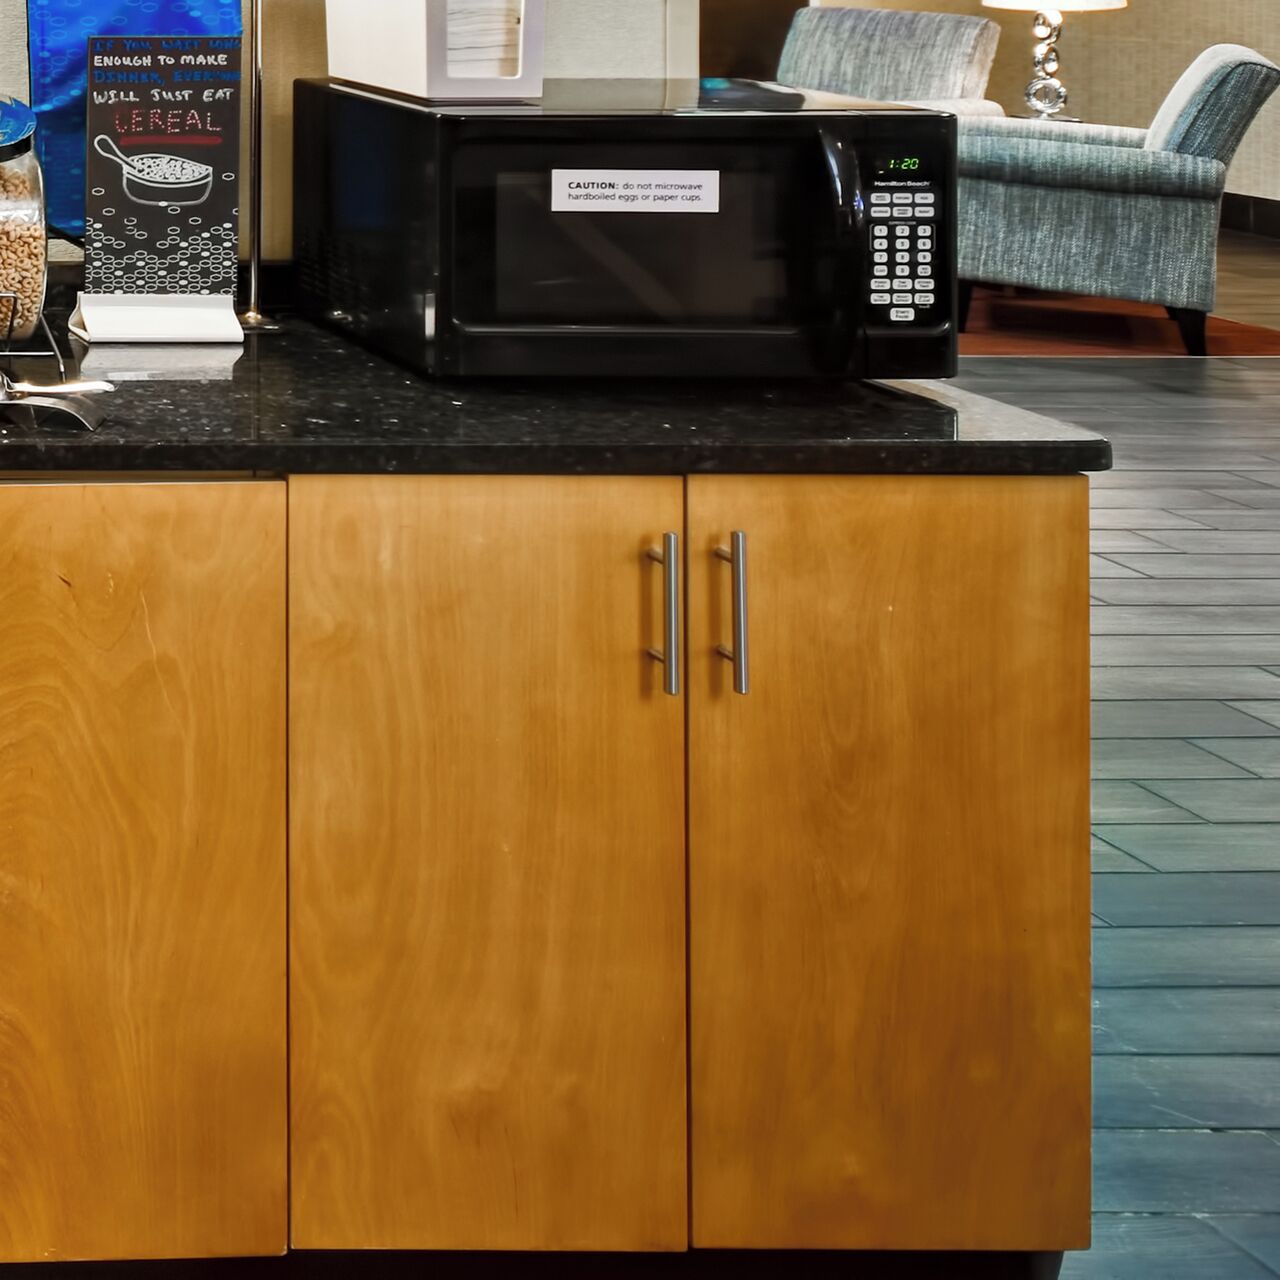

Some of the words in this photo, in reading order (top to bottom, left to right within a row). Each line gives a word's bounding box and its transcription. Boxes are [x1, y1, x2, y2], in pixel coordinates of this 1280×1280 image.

[93, 55, 152, 67] ENOUGH
[157, 54, 175, 65] TO
[180, 53, 228, 66] MAKE
[92, 89, 140, 104] WILL
[150, 88, 193, 102] JUST
[202, 87, 234, 102] EAT
[115, 108, 222, 134] CEREAL
[889, 158, 919, 170] 1:20
[567, 181, 619, 190] CAUTION:
[622, 181, 635, 190] do
[636, 182, 652, 190] not
[654, 182, 703, 191] microwave
[567, 192, 616, 201] hardboiled
[617, 194, 639, 202] eggs
[652, 194, 679, 202] paper
